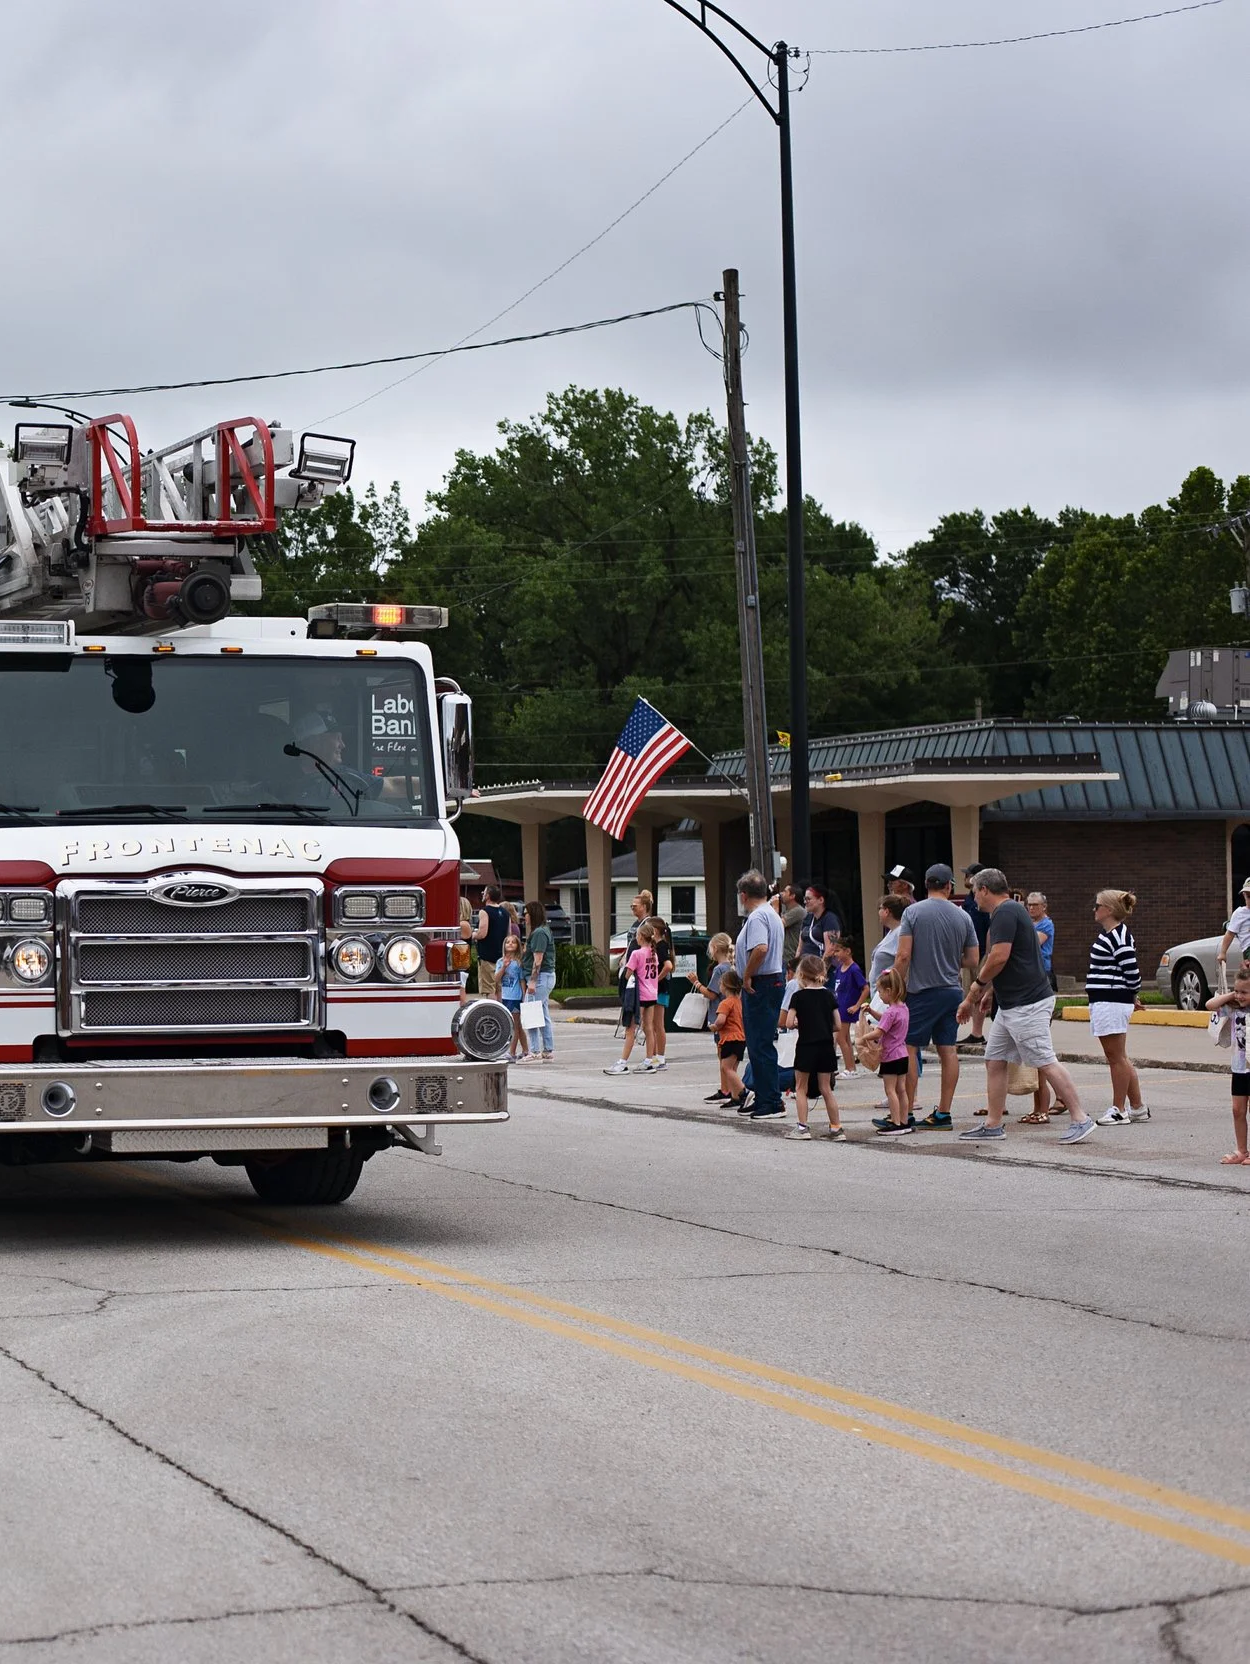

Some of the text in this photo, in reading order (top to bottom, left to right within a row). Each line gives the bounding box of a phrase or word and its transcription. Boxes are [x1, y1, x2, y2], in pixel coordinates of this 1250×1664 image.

[371, 693, 414, 714] Lab
[59, 838, 323, 866] FRONTENAC
[170, 885, 221, 899] Pierce
[645, 965, 657, 980] 23
